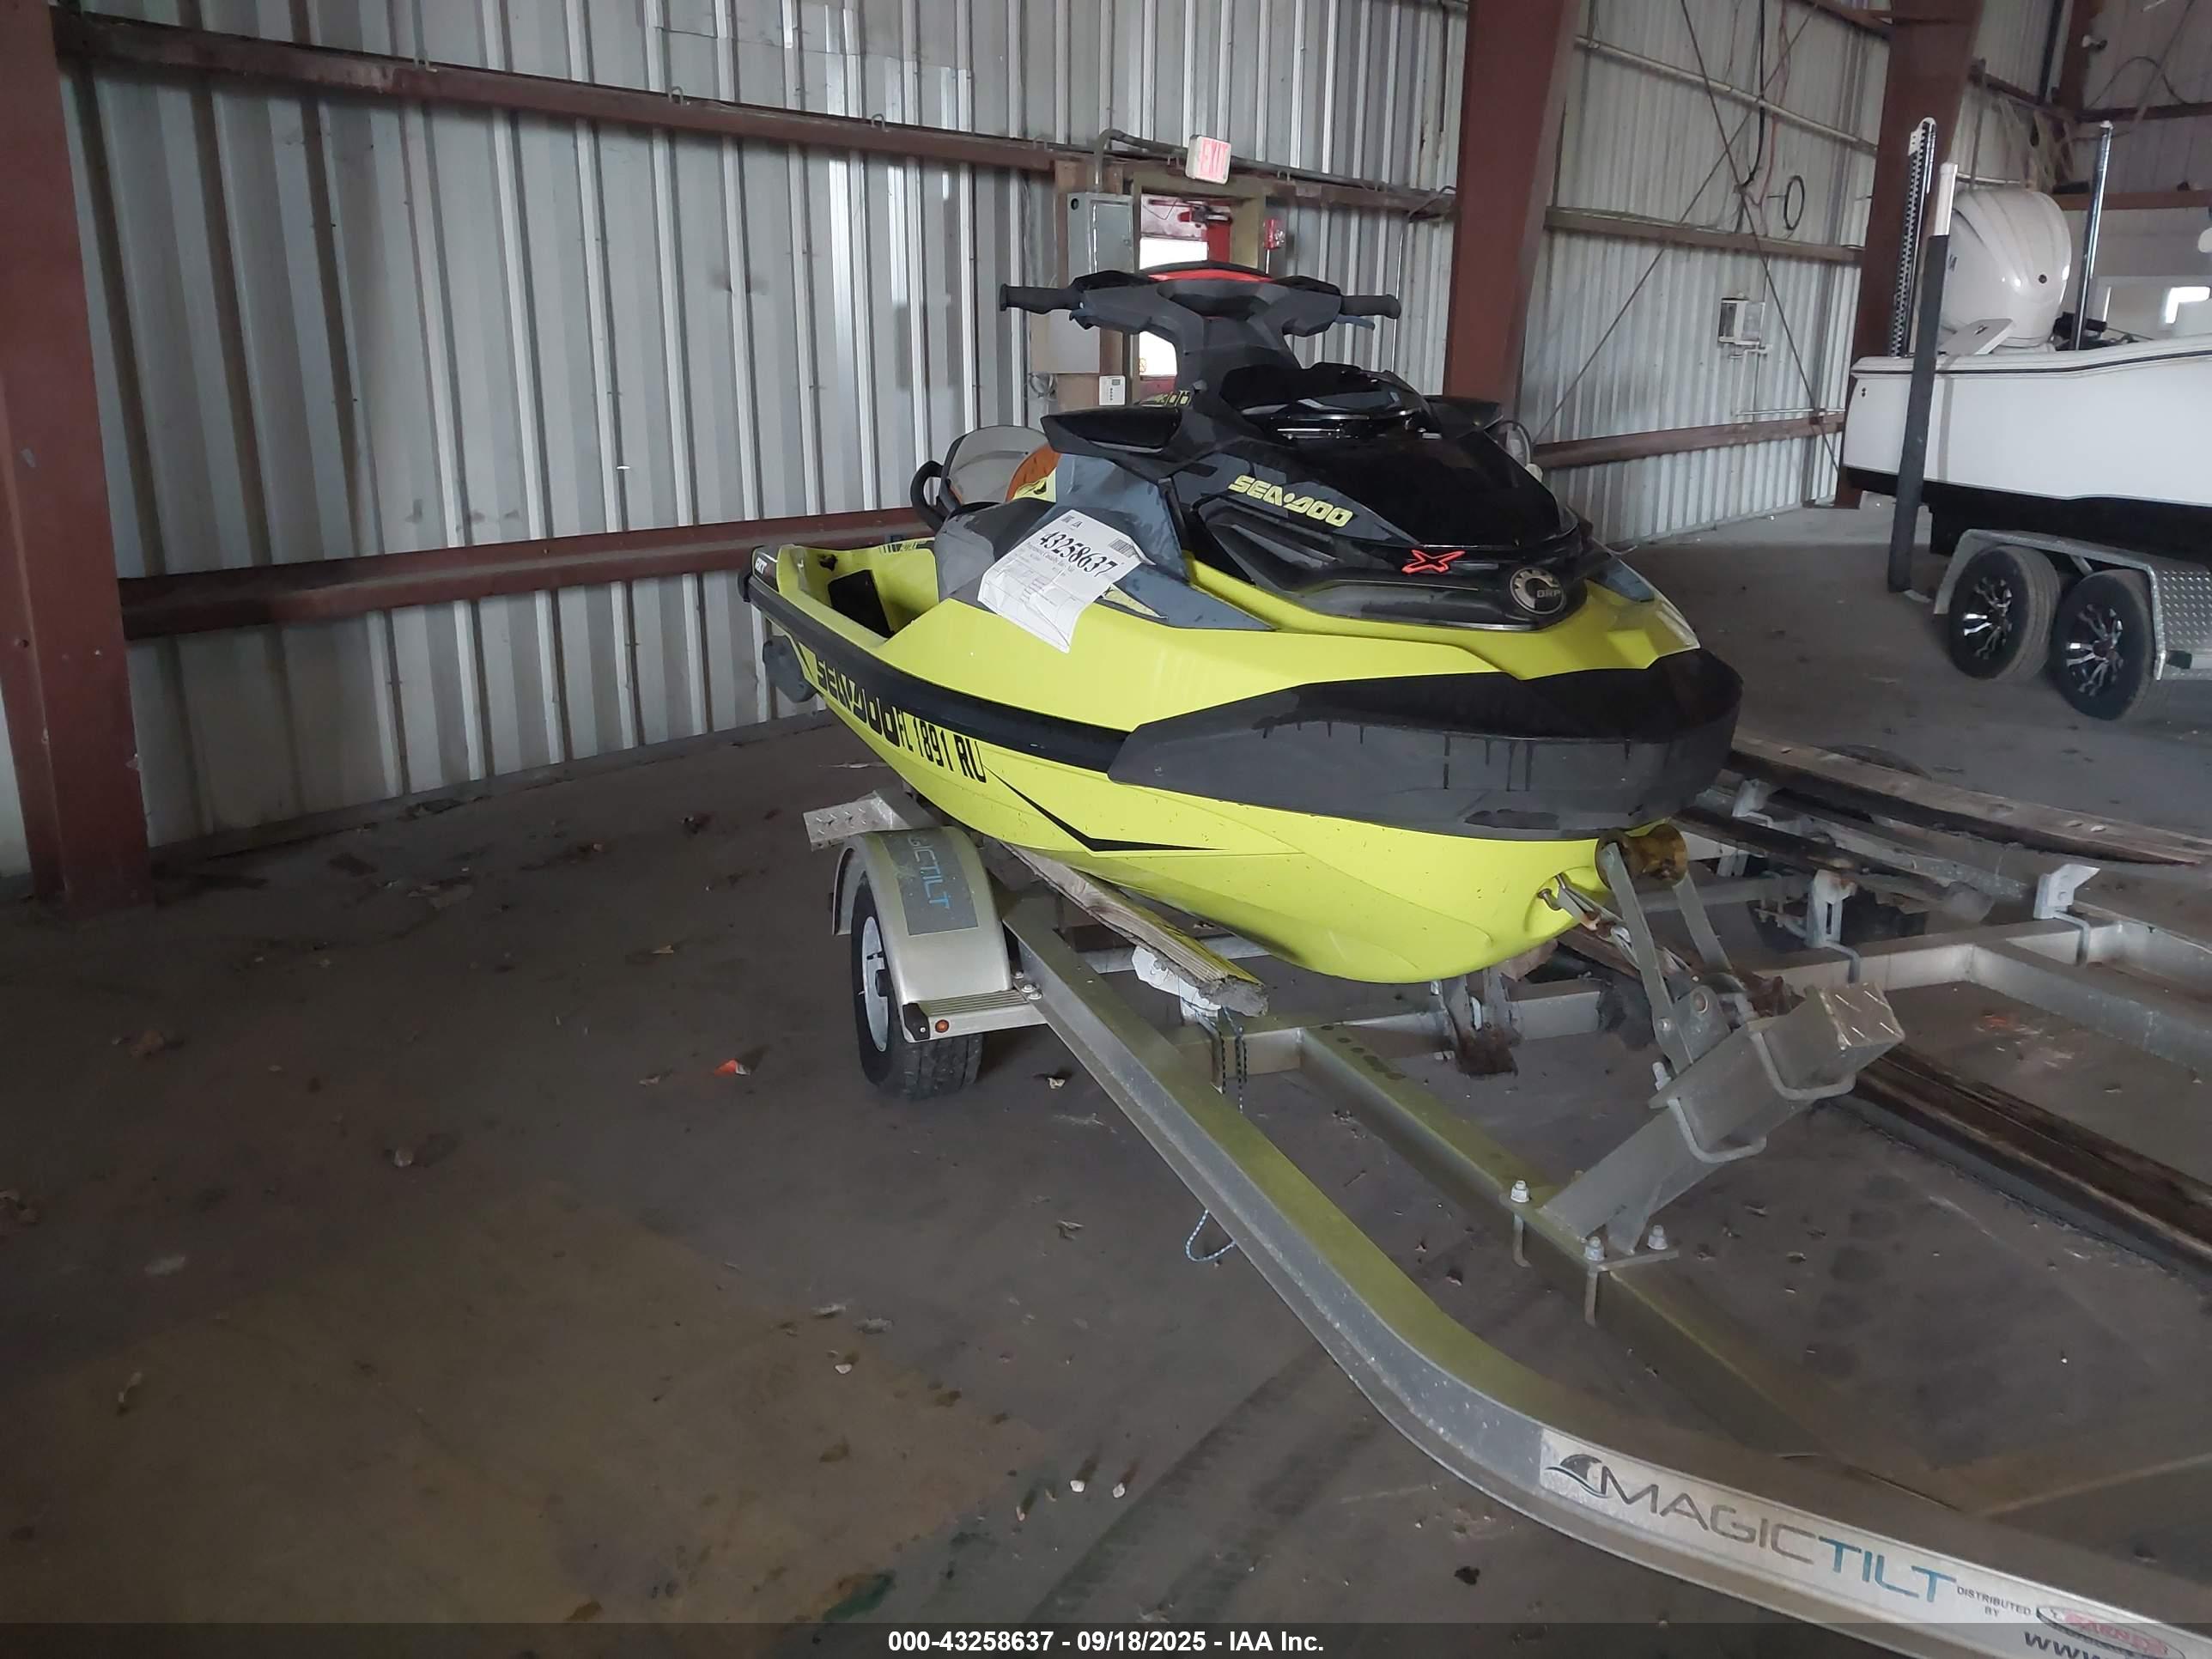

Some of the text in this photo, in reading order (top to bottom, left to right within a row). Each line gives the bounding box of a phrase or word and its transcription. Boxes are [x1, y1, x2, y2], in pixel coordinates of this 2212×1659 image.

[1039, 531, 1119, 578] 43258637
[913, 716, 955, 773] 1891
[954, 734, 988, 784] RU
[1956, 1585, 2033, 1617] DISTRIBUTED
[1984, 1606, 2000, 1619] BY
